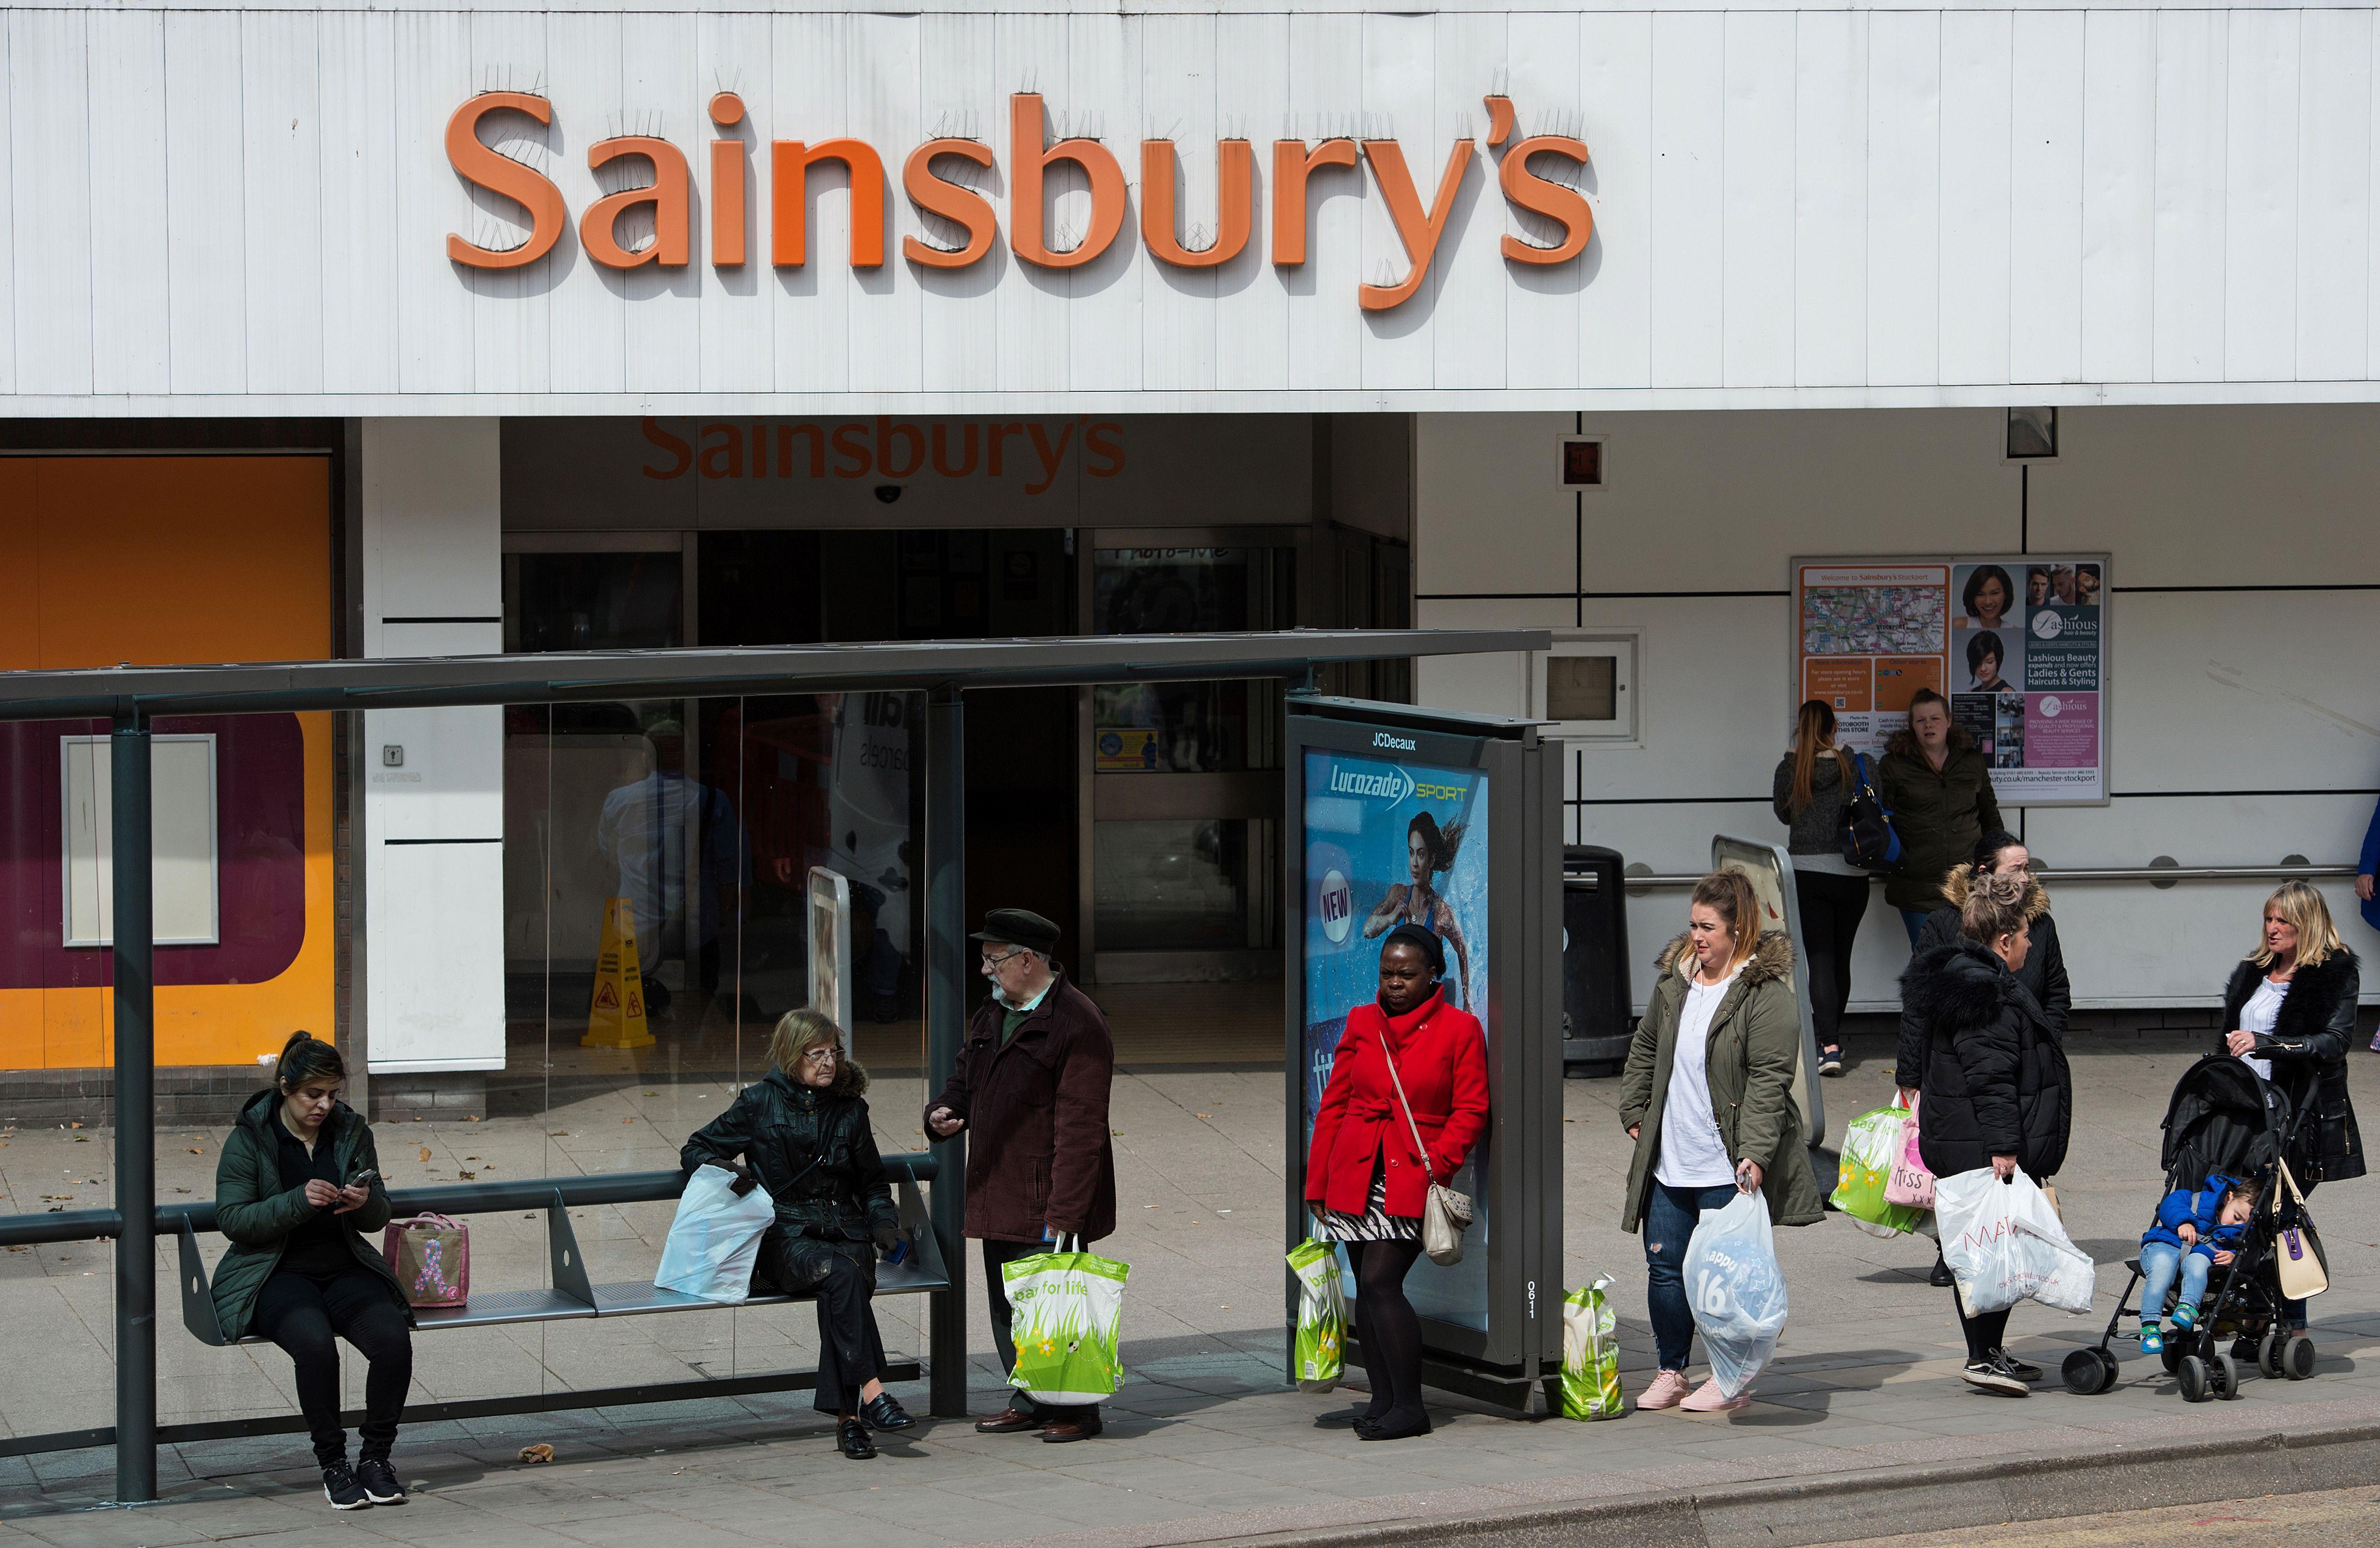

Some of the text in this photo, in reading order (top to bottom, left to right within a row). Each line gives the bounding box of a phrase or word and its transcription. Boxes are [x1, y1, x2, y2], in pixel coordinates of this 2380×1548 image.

[445, 93, 1593, 311] Sainsbury's
[641, 416, 1126, 496] Sainsbury's
[1859, 573, 1896, 582] Sainsbury's
[1897, 574, 1928, 582] Stockport
[2028, 653, 2096, 663] Lashious Beauty
[2029, 669, 2096, 677] Ladies & Gents
[2069, 677, 2096, 686] Styling
[1372, 732, 1416, 751] JCDecaux
[1330, 765, 1467, 802] Lucozade SPORT
[1323, 887, 1348, 924] NEW
[1042, 1280, 1061, 1295] for
[1066, 1280, 1088, 1296] life
[1527, 1281, 1535, 1319] 0611
[1696, 1268, 1727, 1316] 16
